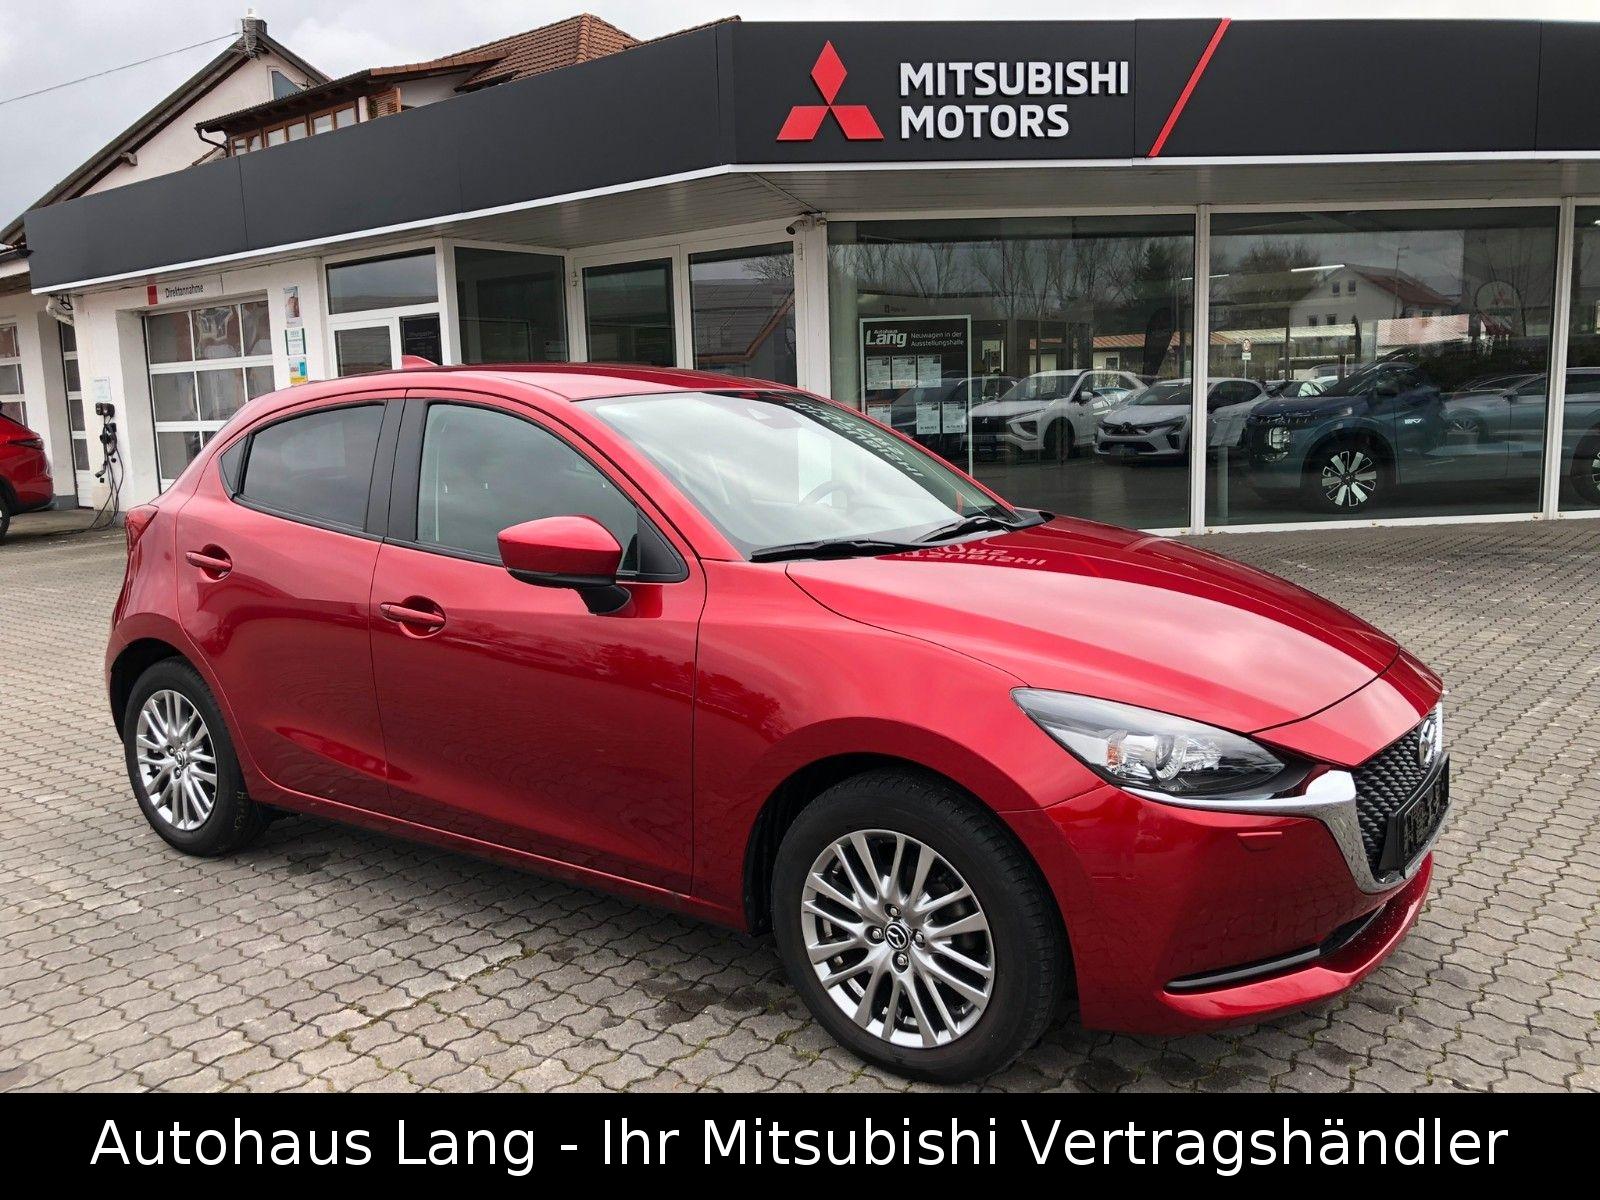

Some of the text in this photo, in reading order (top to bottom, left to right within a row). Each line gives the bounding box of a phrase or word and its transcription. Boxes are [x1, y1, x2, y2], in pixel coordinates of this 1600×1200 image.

[900, 61, 1128, 96] MITSUBISHI
[901, 104, 1069, 139] MOTORS
[165, 284, 204, 298] Direktannahme
[865, 330, 907, 347] Lang
[911, 332, 944, 340] Neuwagen
